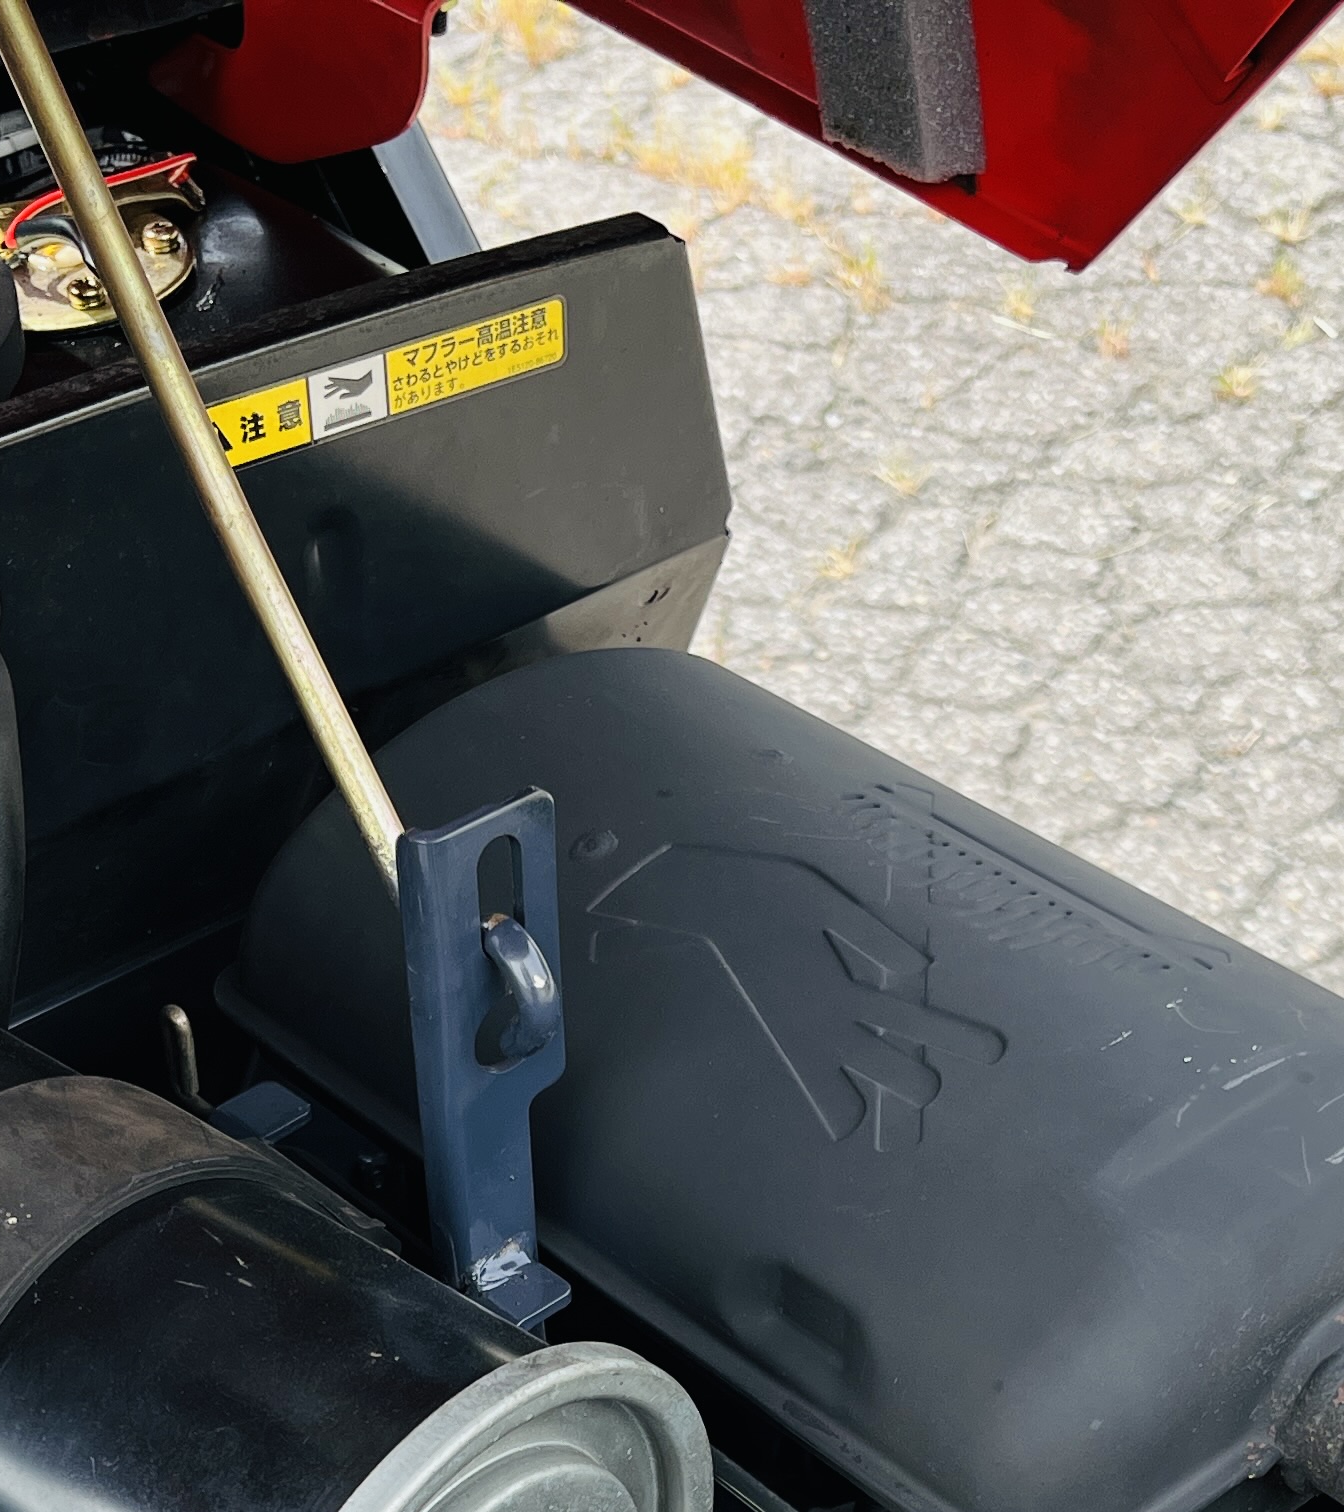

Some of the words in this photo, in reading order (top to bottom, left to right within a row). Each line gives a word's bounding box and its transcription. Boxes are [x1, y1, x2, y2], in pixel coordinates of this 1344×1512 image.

[392, 328, 558, 391] さわるとやけどをするおそれ
[402, 306, 546, 366] マフラー高温注意
[394, 377, 467, 408] があります。
[240, 400, 303, 443] 注意
